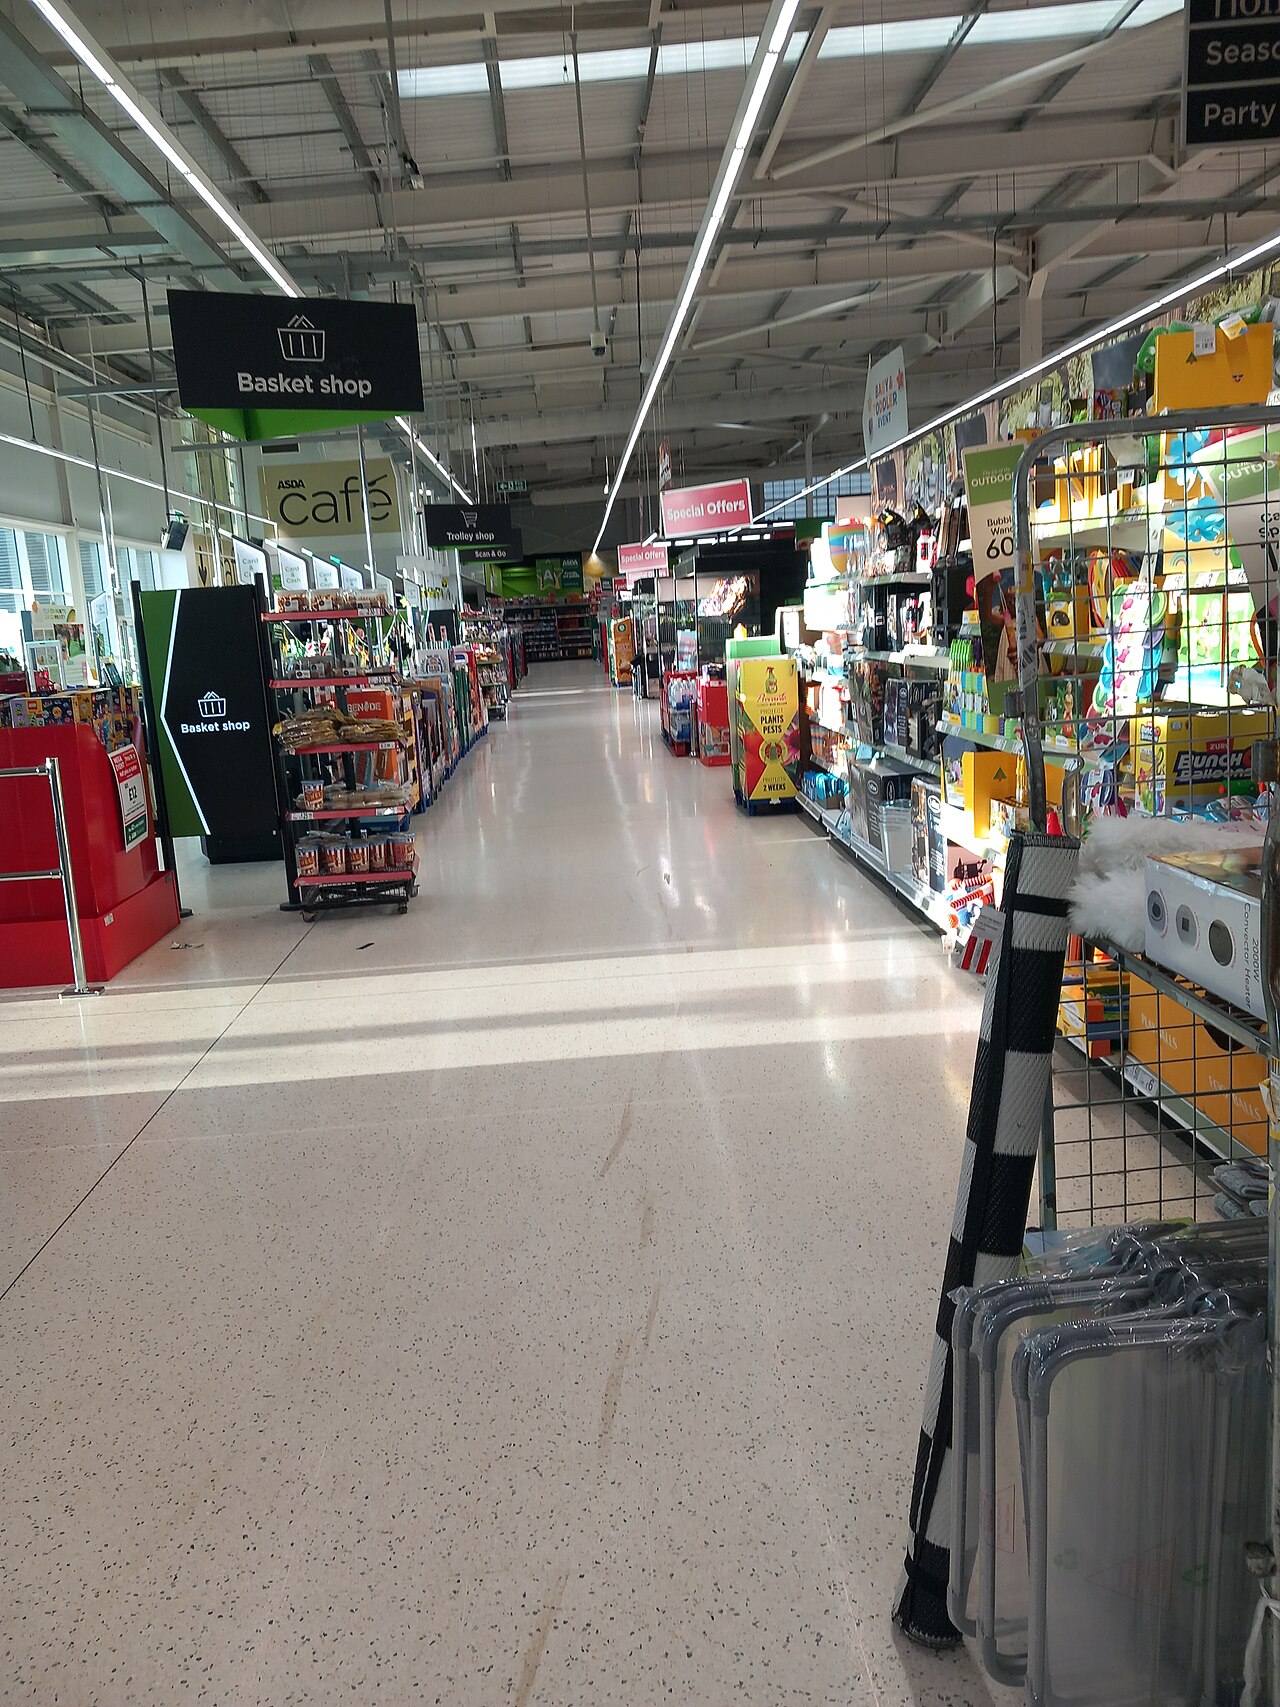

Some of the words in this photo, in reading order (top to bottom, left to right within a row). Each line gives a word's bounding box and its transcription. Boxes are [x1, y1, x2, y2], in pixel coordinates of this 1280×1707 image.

[1204, 100, 1277, 127] Party
[237, 371, 314, 394] Basket
[320, 373, 372, 399] shop
[877, 412, 892, 429] EVENT
[278, 479, 306, 490] ASDA
[971, 471, 1015, 488] OUTDOO
[279, 474, 392, 526] café
[667, 502, 705, 523] Special
[706, 499, 746, 515] Offers
[987, 515, 1013, 527] Bubbl
[446, 531, 474, 542] Trolley
[475, 531, 495, 542] shop
[474, 550, 491, 558] Scan
[497, 549, 507, 558] Go
[621, 553, 644, 564] Special
[644, 550, 665, 560] Offers
[242, 557, 259, 565] Card
[284, 565, 300, 573] Card
[285, 576, 302, 584] Cash
[760, 714, 785, 725] PLANTS
[180, 721, 220, 734] Basket
[222, 720, 251, 732] shop
[762, 724, 783, 735] PESTS
[1177, 752, 1244, 771] BUNCH
[763, 784, 768, 792] 2
[768, 782, 787, 792] WEEKS
[1243, 902, 1251, 965] Convector
[1252, 938, 1260, 983] 2000W
[1243, 967, 1251, 1009] Heater
